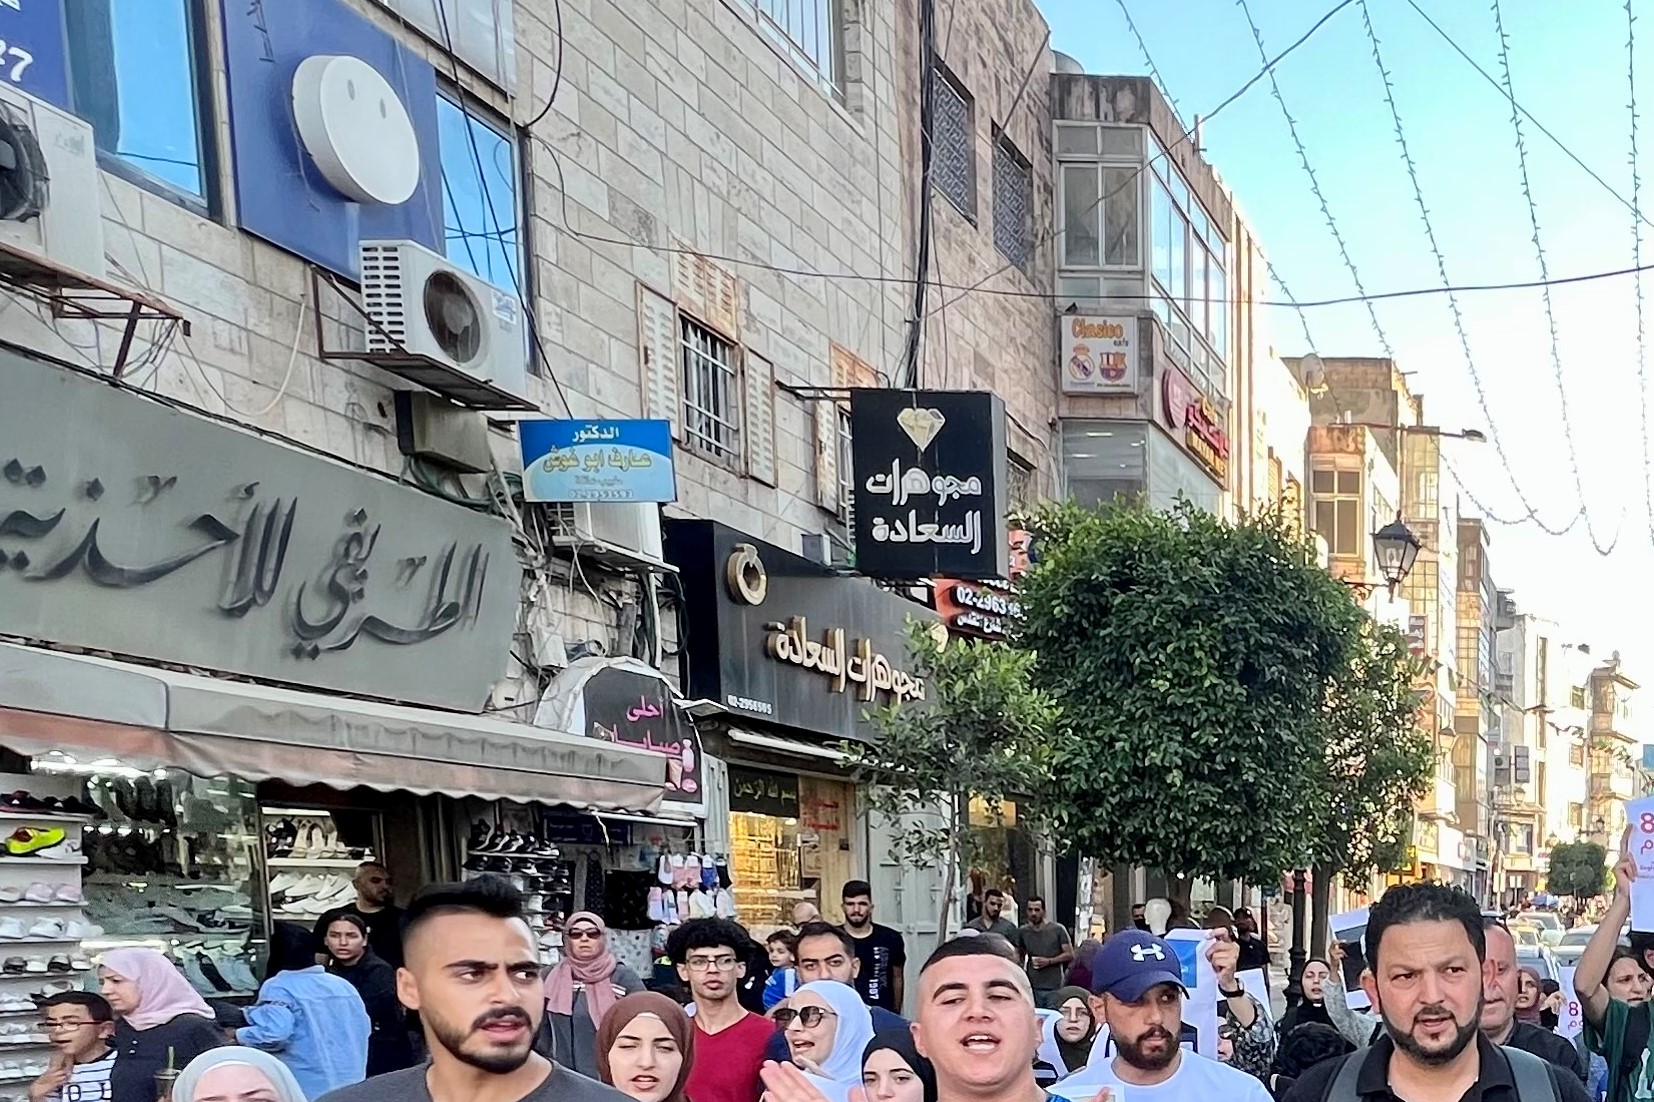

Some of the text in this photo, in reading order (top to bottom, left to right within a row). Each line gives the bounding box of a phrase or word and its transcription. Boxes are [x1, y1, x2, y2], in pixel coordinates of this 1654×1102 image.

[0, 39, 34, 82] 7
[572, 423, 620, 443] الدكتور
[866, 458, 982, 517] مجوهرات
[872, 509, 982, 555] السعادة
[766, 615, 926, 705] مجوهرات السعادة
